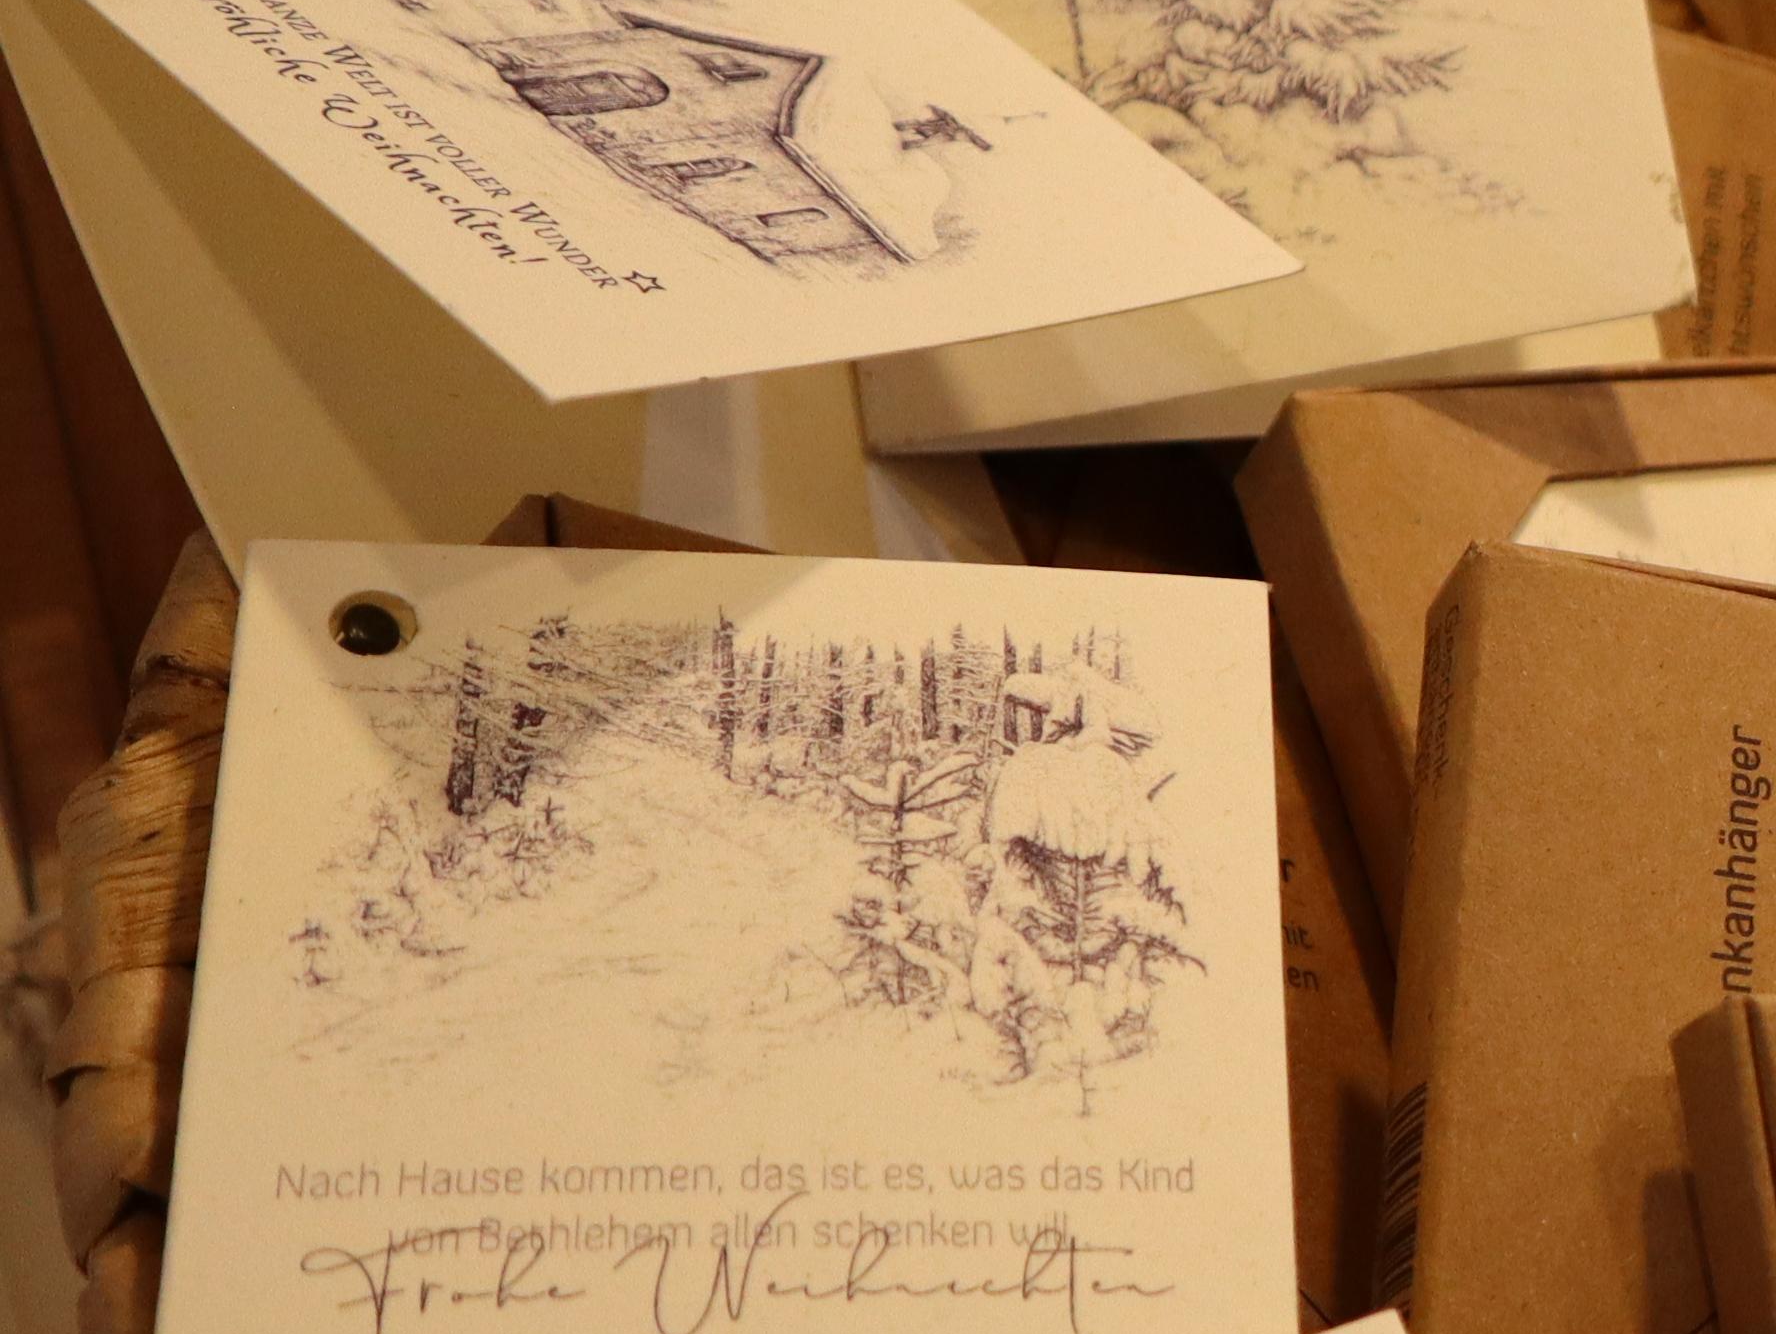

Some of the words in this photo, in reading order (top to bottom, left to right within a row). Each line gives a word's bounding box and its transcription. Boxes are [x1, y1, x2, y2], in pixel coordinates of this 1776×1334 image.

[1709, 724, 1773, 994] nkanhänger
[276, 1160, 380, 1199] Nach
[399, 1160, 523, 1198] Hause
[541, 1158, 723, 1197] kommen,
[740, 1154, 806, 1193] das
[822, 1157, 870, 1192] ist
[884, 1164, 933, 1195] es,
[948, 1164, 1025, 1193] was
[1040, 1155, 1102, 1193] das
[1119, 1157, 1195, 1193] Kind
[479, 1214, 692, 1255] Bethlehem
[710, 1212, 797, 1249] allen
[813, 1210, 993, 1249] schenken
